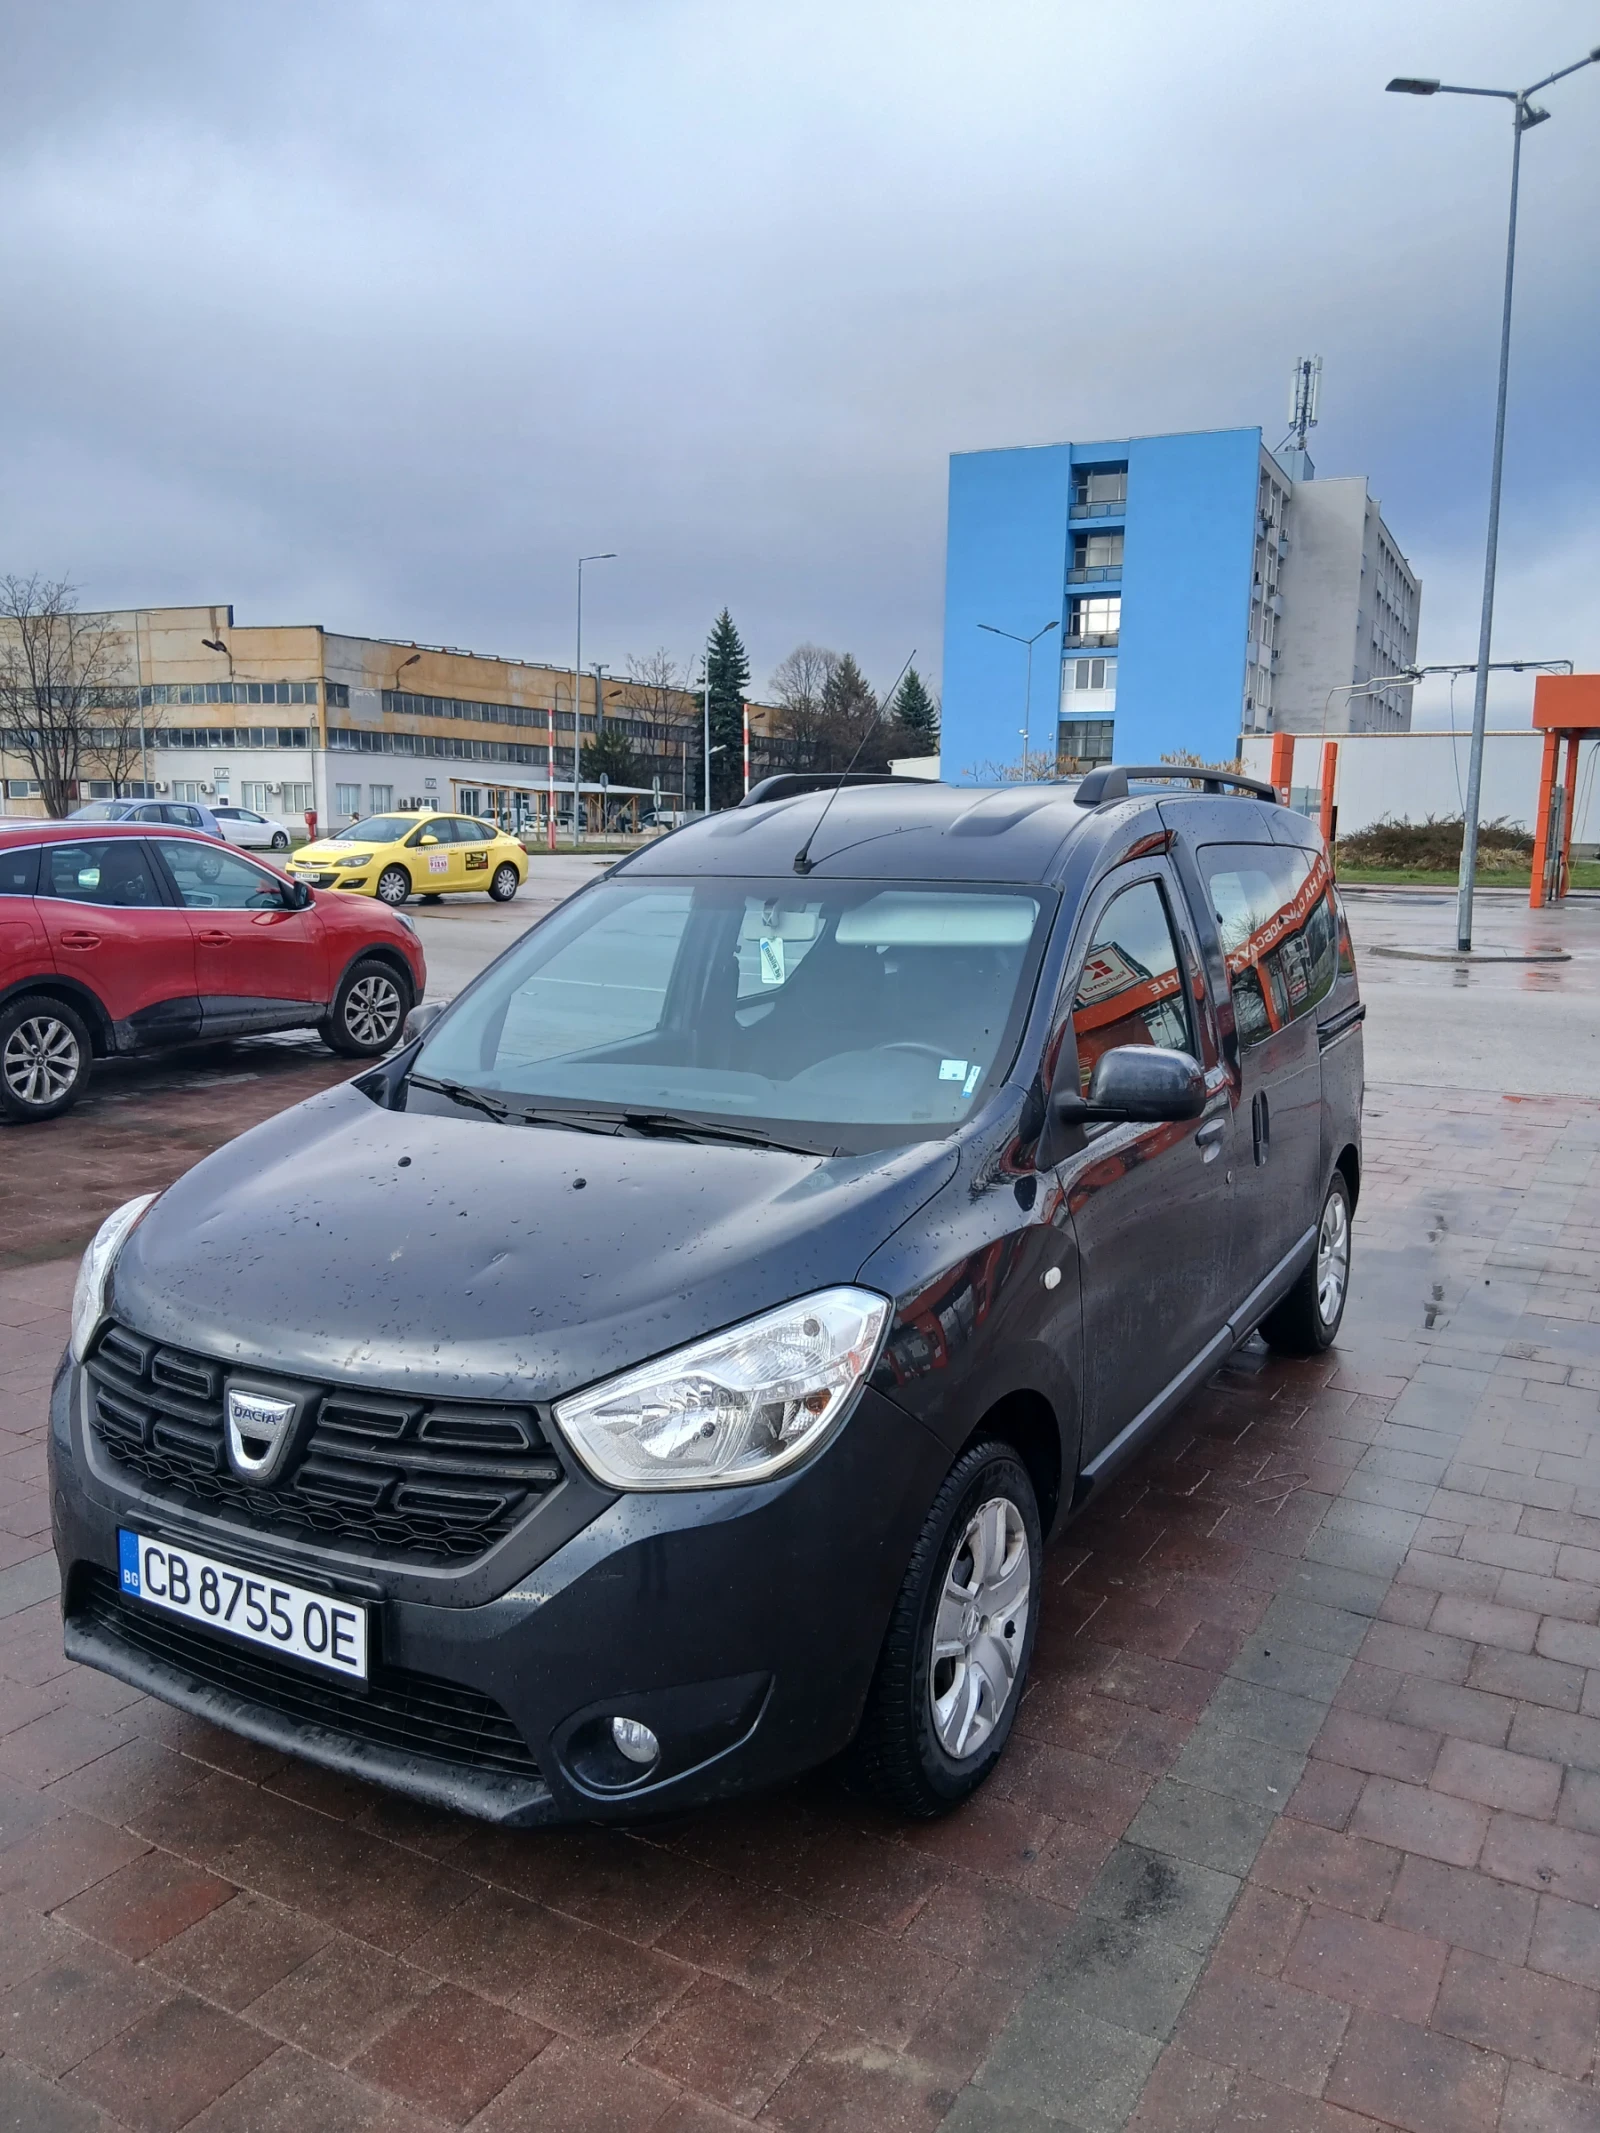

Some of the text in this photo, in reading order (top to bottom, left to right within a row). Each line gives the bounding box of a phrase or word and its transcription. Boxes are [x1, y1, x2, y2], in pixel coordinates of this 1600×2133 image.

[764, 947, 782, 980] mobile.bg
[234, 1405, 277, 1426] DACIA
[123, 1569, 139, 1587] BG
[144, 1546, 191, 1605] CB
[199, 1566, 293, 1641] 8755
